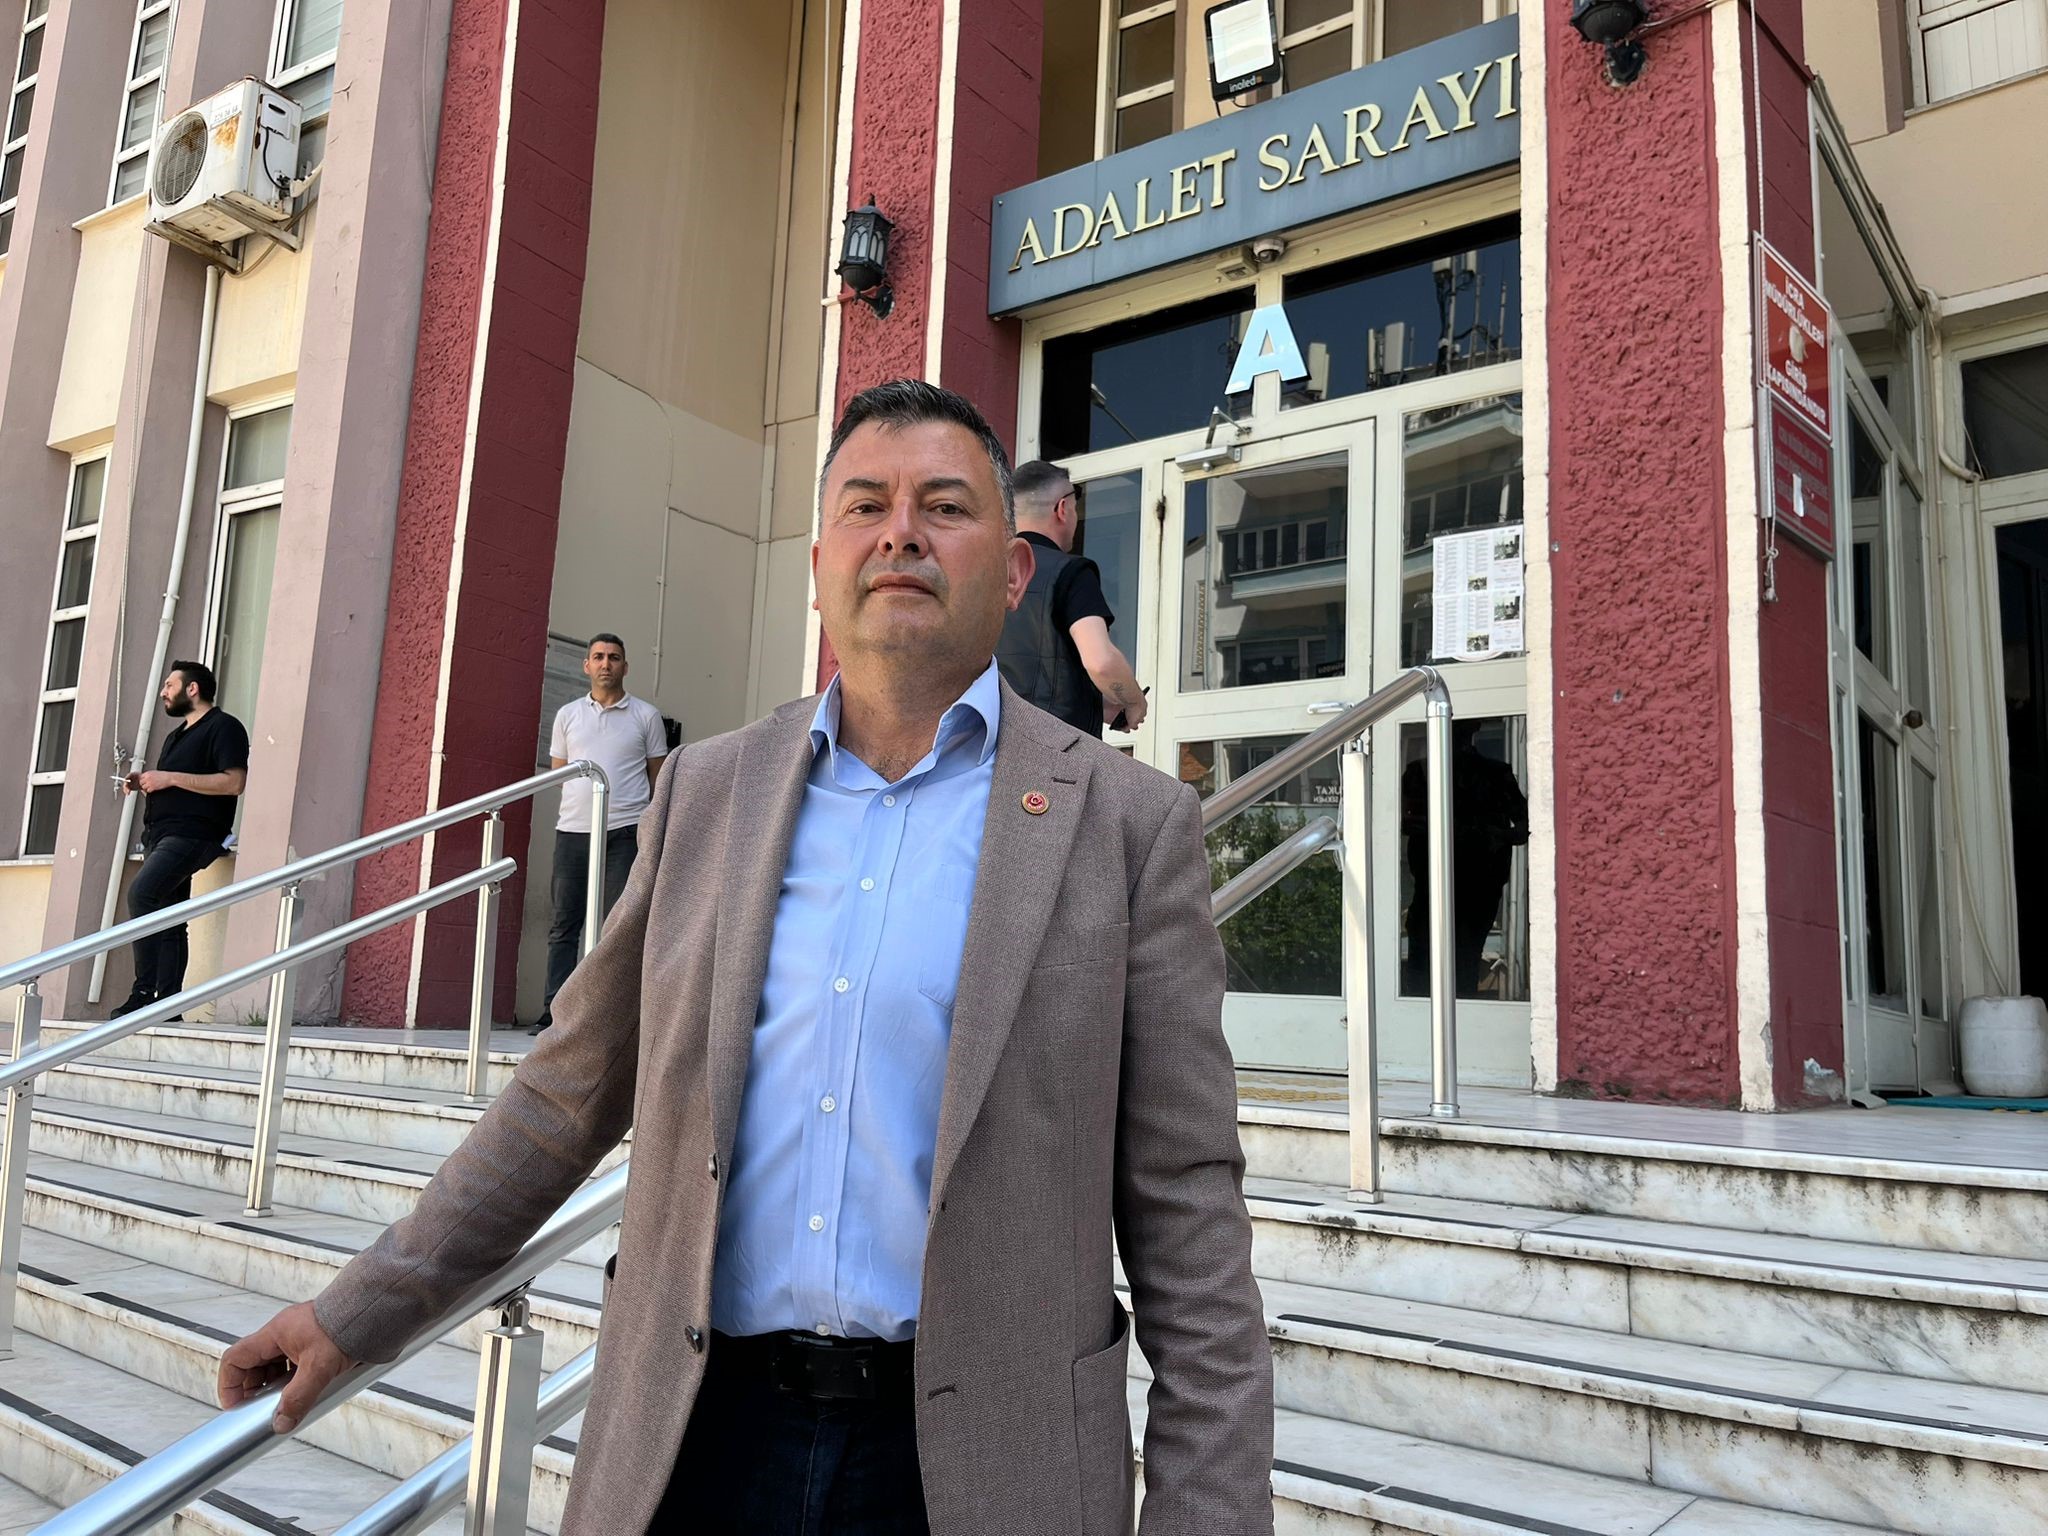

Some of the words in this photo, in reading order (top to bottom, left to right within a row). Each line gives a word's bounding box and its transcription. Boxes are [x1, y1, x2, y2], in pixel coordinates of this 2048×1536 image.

[1228, 75, 1256, 93] inoled
[1008, 149, 1237, 273] ADALET
[1257, 52, 1519, 192] SARAYI
[1785, 275, 1805, 309] İCRA
[1223, 303, 1311, 396] A
[1785, 358, 1807, 391] GİRİŞ
